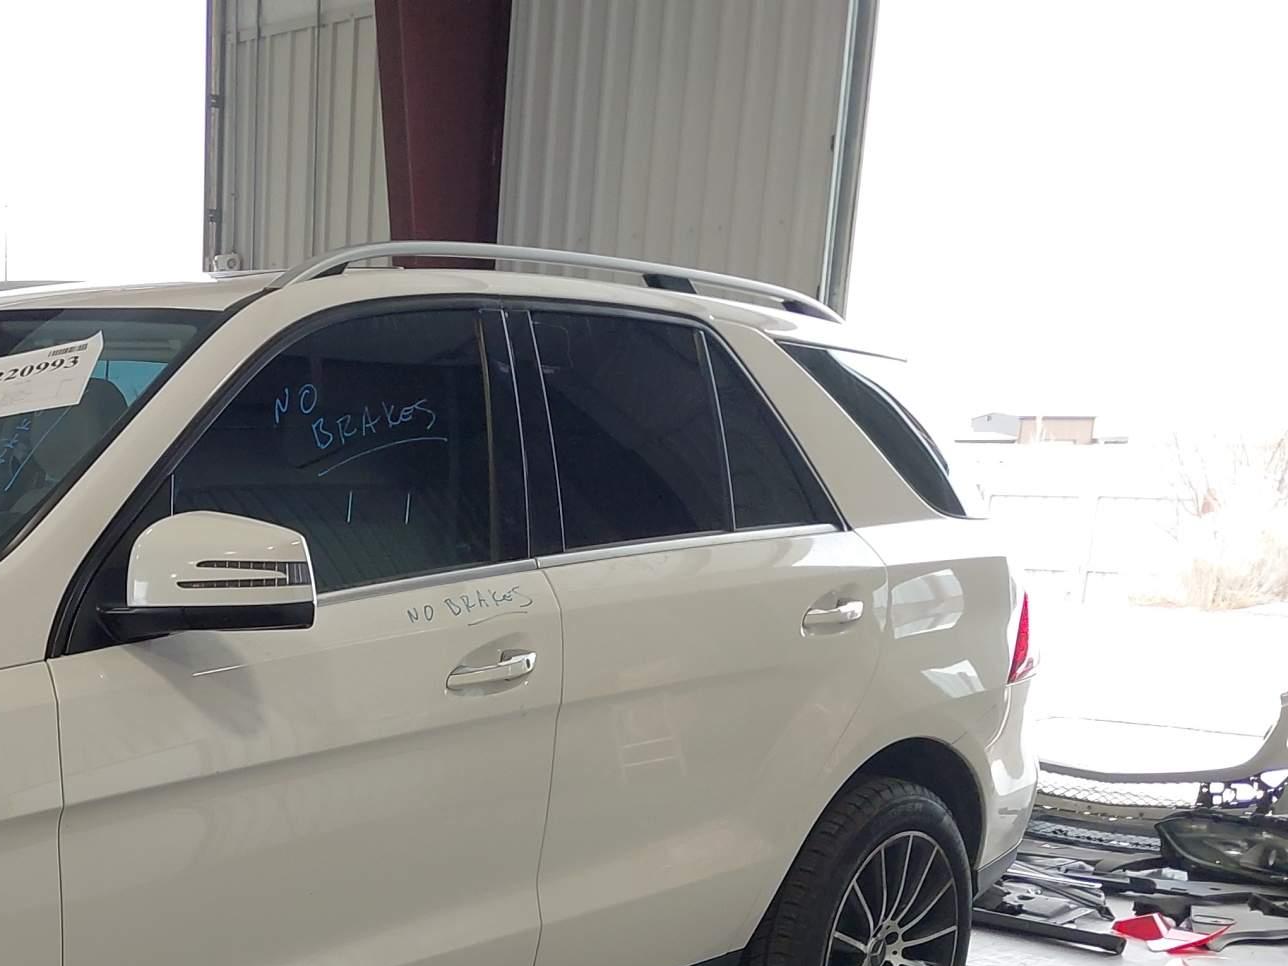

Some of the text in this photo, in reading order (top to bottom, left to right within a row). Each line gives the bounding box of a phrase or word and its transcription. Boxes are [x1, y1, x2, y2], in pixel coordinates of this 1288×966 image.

[274, 383, 318, 423] NO
[311, 398, 437, 449] BRAKES
[406, 585, 534, 623] NO BRAKES
